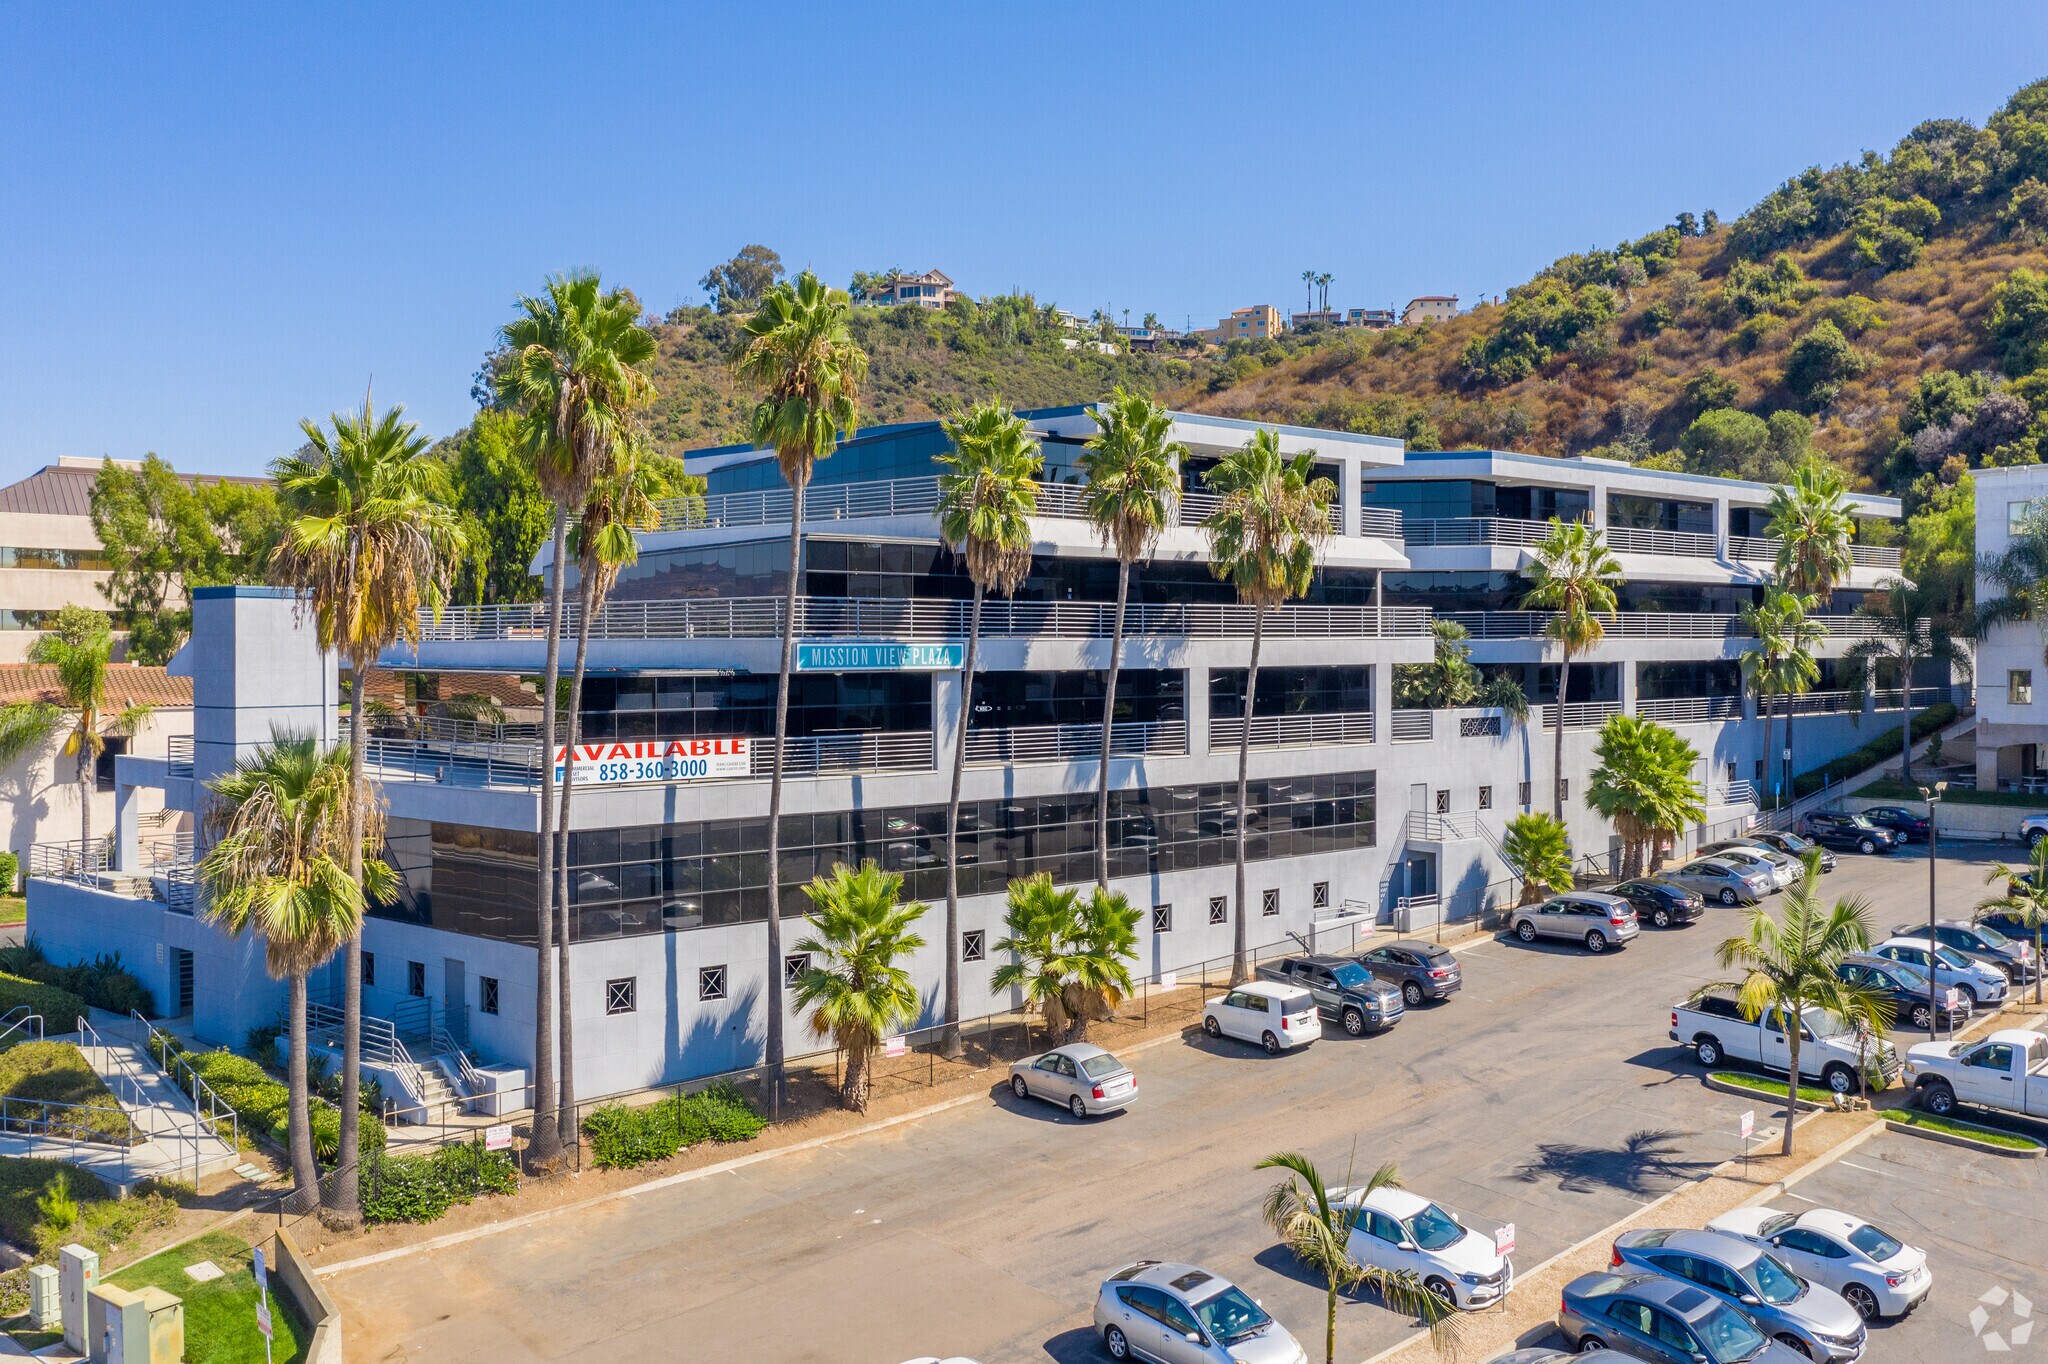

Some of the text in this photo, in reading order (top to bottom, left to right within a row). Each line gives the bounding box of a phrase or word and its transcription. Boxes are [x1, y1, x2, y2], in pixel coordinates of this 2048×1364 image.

[811, 647, 951, 666] MISSION VIEW PLAZA
[555, 738, 746, 762] AVAILABLE
[599, 759, 707, 781] 858-360-3000
